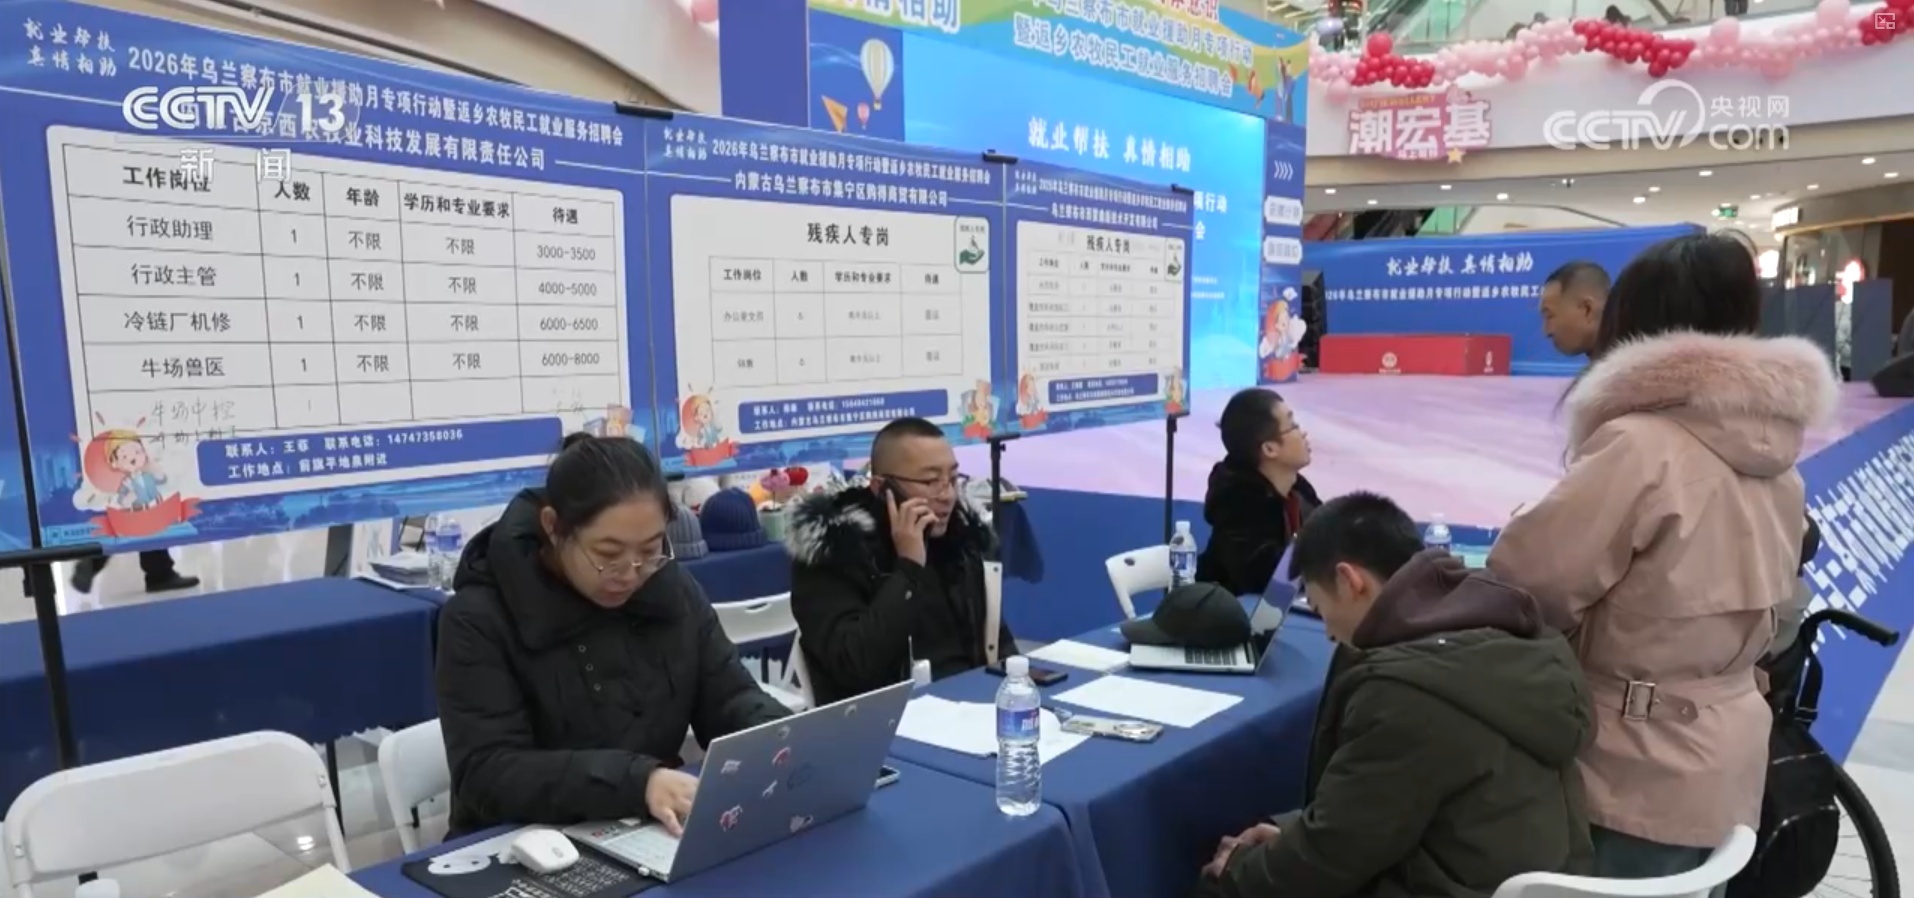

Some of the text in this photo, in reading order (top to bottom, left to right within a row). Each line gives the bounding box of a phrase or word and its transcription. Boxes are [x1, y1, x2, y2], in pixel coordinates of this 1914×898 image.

[23, 18, 116, 53] 就业帮扶
[27, 46, 118, 77] 真情相助
[1013, 14, 1233, 98] 暨返乡农牧民工就业服务招聘会
[1350, 100, 1490, 154] 潮宏基
[1028, 117, 1191, 172] 就业帮扶 真情相助
[122, 166, 579, 225] 工作岗位 人数 年龄 学历和专业要求 待遇
[127, 215, 596, 261] 行政助理 1 不限 不限 3000-3500
[807, 223, 889, 246] 残疾人专岗
[131, 263, 597, 297] 行政主管 1 不限 不限 4000-5000
[723, 268, 762, 281] 工作岗位
[790, 270, 808, 283] 人数
[835, 271, 892, 285] 学历和专业要求
[1386, 251, 1534, 277] 就业帮扶 真情相助
[123, 311, 599, 333] 冷链厂机修 1 不限 不限 6000-6500
[140, 352, 600, 379] 牛场兽医 1 不限 不限 6000-8000
